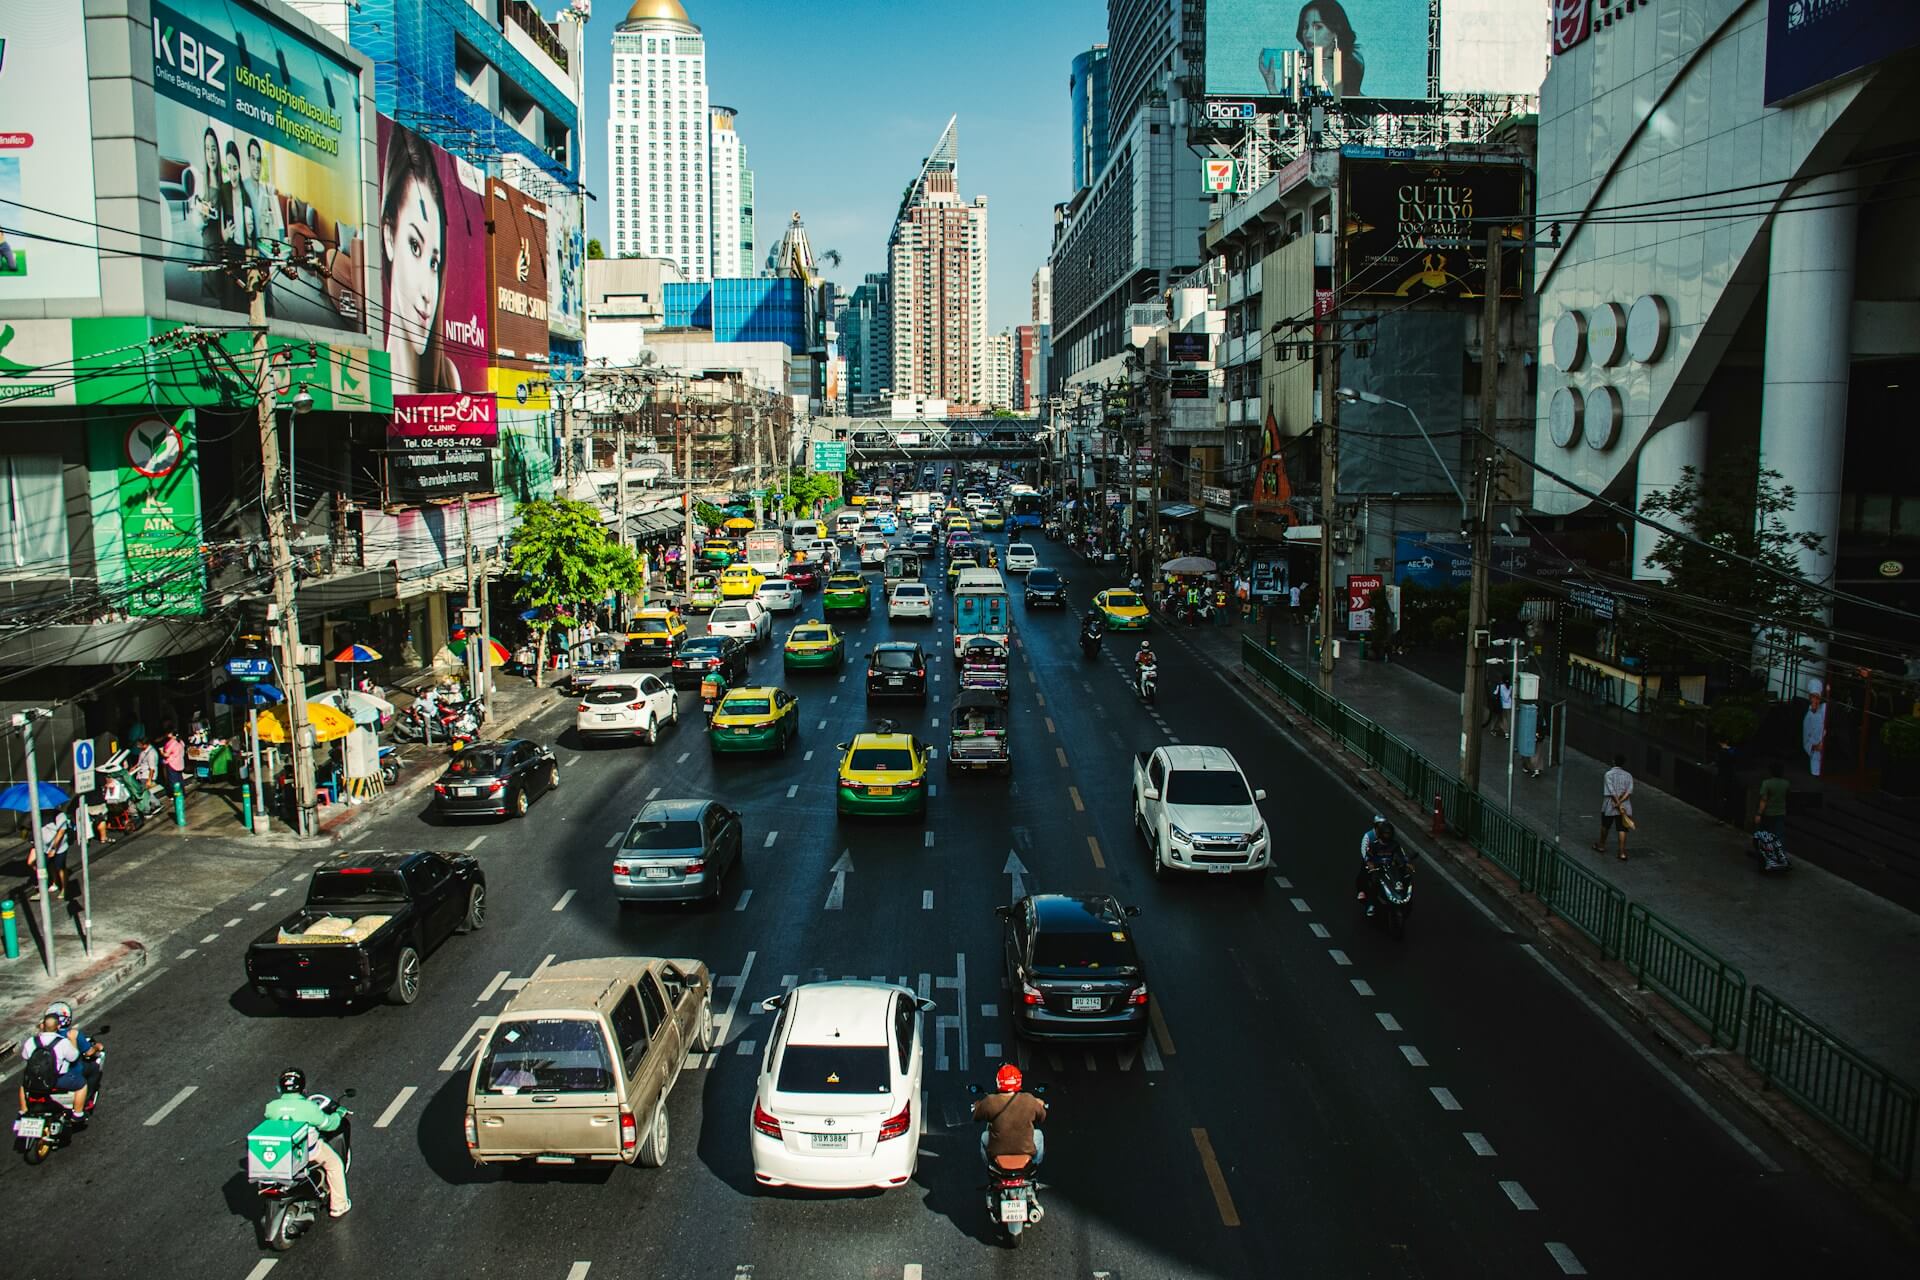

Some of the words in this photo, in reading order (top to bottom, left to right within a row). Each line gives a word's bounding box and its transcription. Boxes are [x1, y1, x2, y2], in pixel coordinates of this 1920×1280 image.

[153, 16, 175, 67] K
[180, 31, 225, 92] BIZ
[155, 65, 175, 84] Online
[176, 75, 201, 99] Banking
[201, 87, 226, 108] Platform
[1210, 165, 1229, 190] 7
[1399, 203, 1460, 223] UNITY
[1398, 222, 1461, 235] FOOBALL
[445, 315, 485, 348] NITIPON
[394, 399, 490, 425] NITIPON
[427, 423, 457, 432] CLINIC
[404, 438, 420, 448] Tel.
[421, 437, 482, 448] 02-653-4742
[143, 518, 176, 531] ATM
[257, 661, 268, 671] 17
